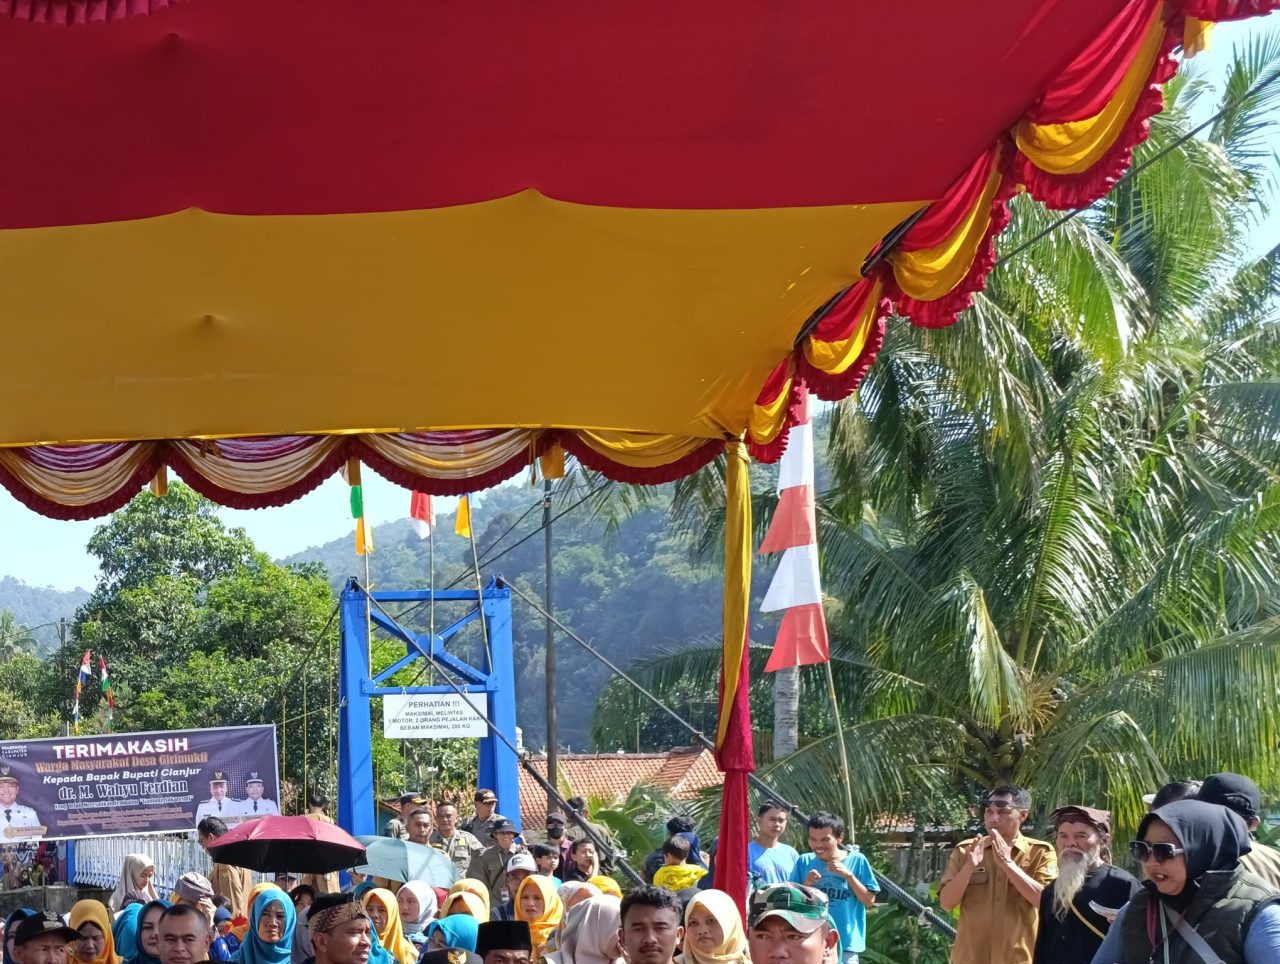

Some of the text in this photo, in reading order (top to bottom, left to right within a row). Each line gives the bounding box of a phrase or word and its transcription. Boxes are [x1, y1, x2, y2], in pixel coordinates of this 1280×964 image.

[52, 738, 189, 759] TERIMAKASIH
[36, 752, 208, 774] Warga Masyarakat Desa Girimukti
[43, 766, 202, 785] Kepada Bapak Bupati Cianjur
[58, 780, 188, 800] dr. M. Wahyu Ferdian
